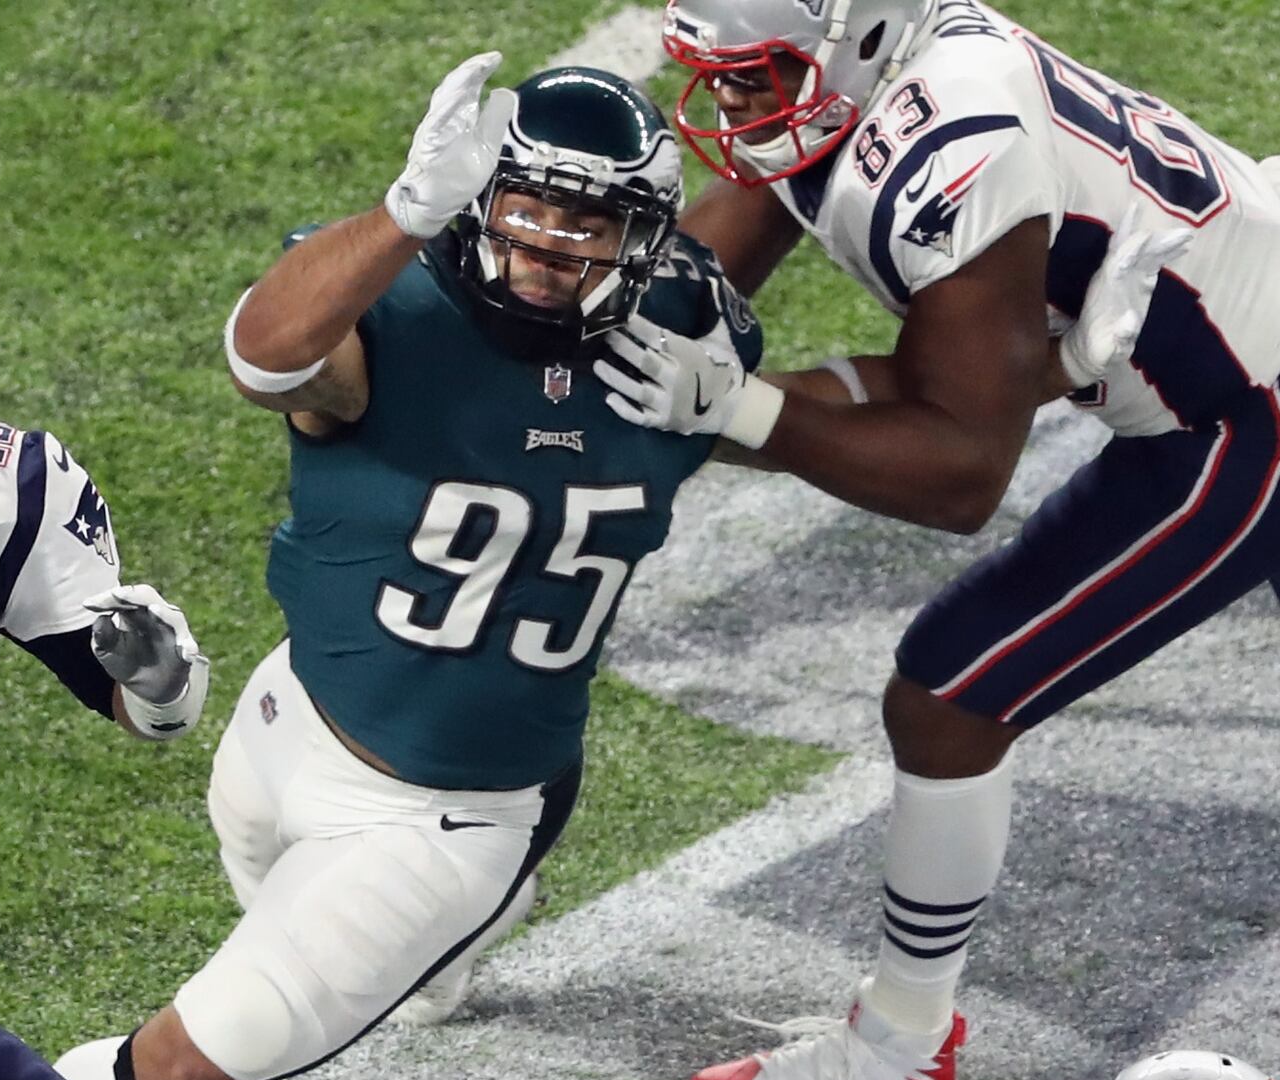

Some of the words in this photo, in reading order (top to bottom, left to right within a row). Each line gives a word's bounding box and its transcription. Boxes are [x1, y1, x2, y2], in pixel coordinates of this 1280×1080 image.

[853, 77, 941, 190] 83
[1012, 27, 1232, 229] 8
[373, 480, 649, 672] 95
